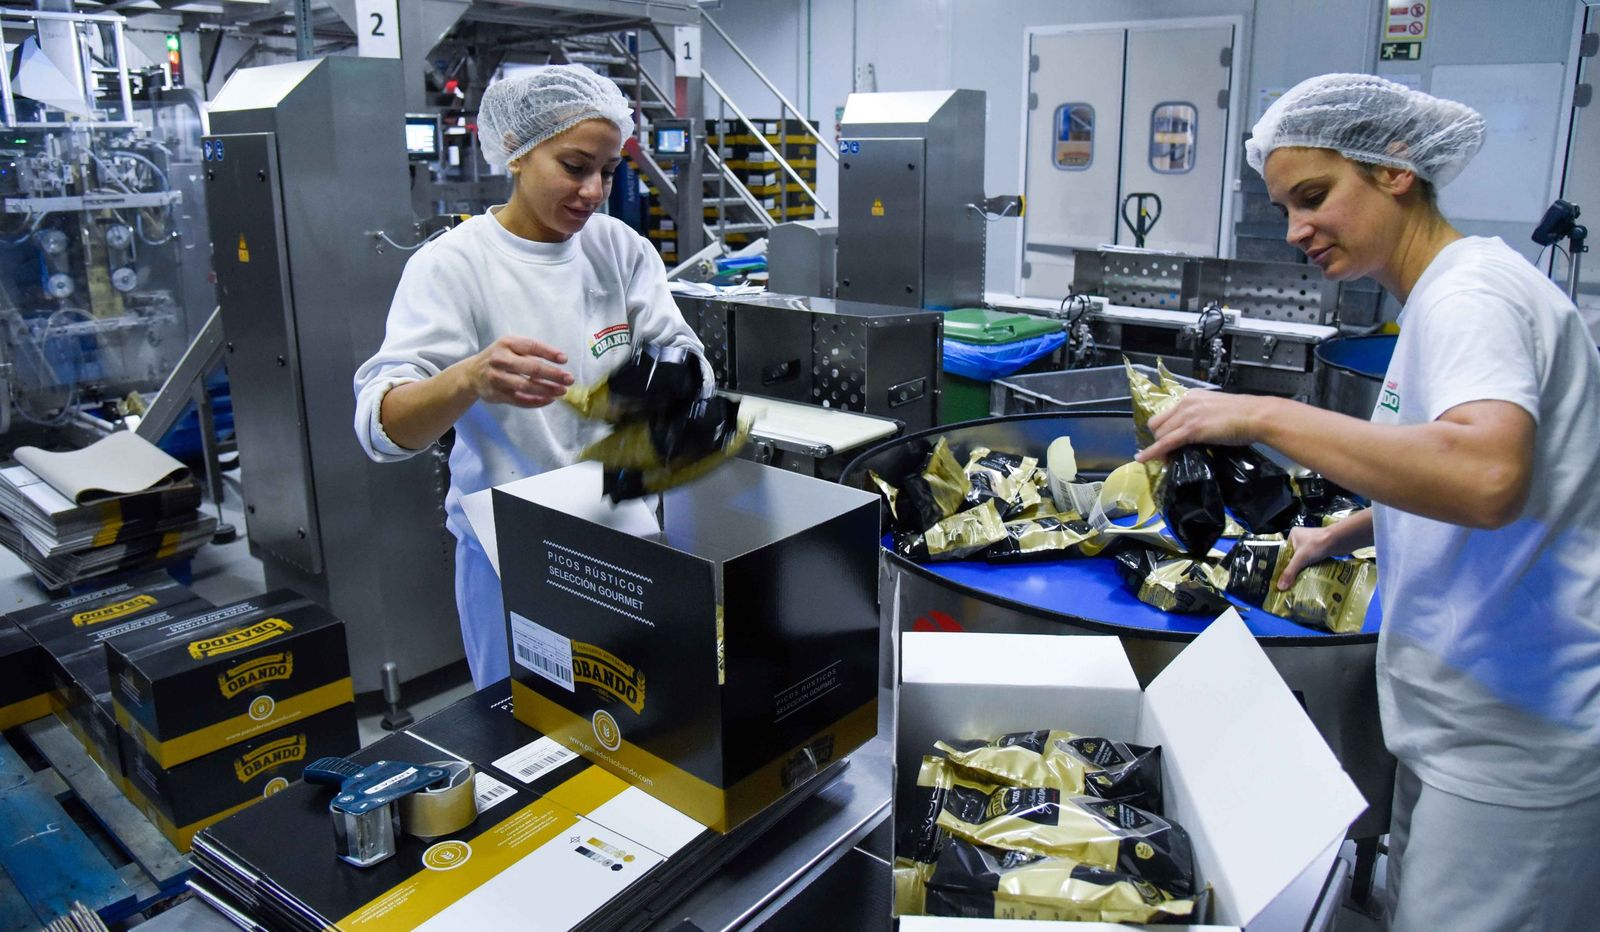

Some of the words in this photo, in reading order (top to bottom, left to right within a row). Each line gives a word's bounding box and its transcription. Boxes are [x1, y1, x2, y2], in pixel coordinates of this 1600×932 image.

[370, 12, 385, 36] 2
[683, 41, 692, 60] 1
[547, 550, 580, 571] PICOS
[584, 565, 644, 596] RÚSTICOS
[548, 565, 597, 592] SELECCIÓN
[598, 585, 645, 611] GOURMET
[197, 621, 278, 650] OBANDO
[227, 664, 288, 693] OBANDO
[572, 658, 638, 704] OBANDO
[243, 746, 300, 776] OBANDO
